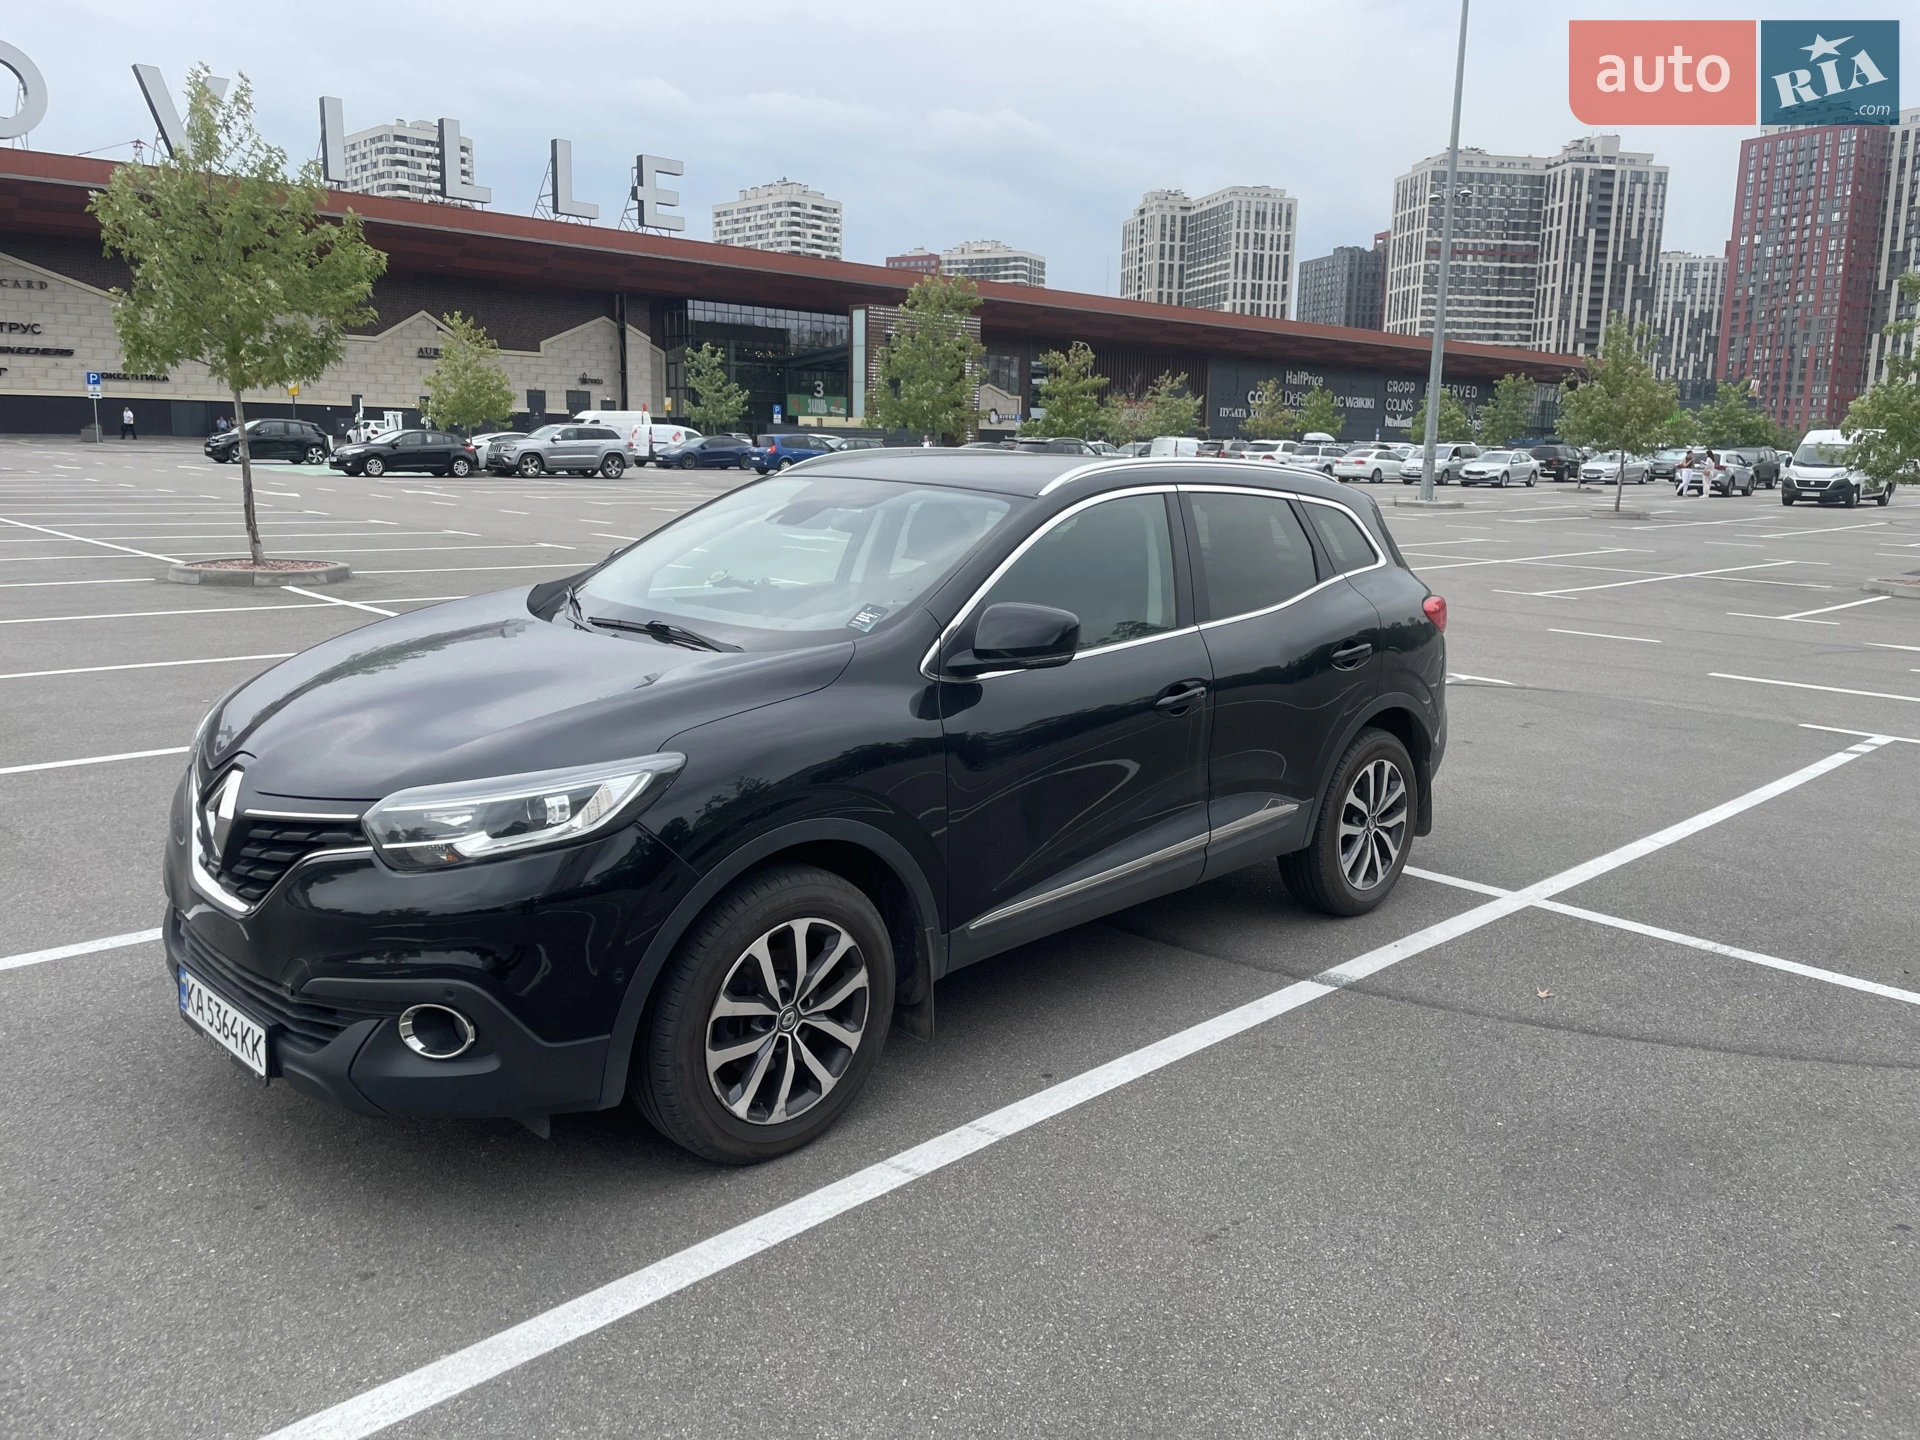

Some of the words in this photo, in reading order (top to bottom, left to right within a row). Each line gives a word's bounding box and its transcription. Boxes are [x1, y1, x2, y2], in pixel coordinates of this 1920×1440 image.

[90, 373, 98, 384] P
[1285, 370, 1324, 386] HalfPrice
[813, 381, 824, 398] 3
[1386, 380, 1416, 394] CROPP
[186, 979, 263, 1068] KA5364KK
